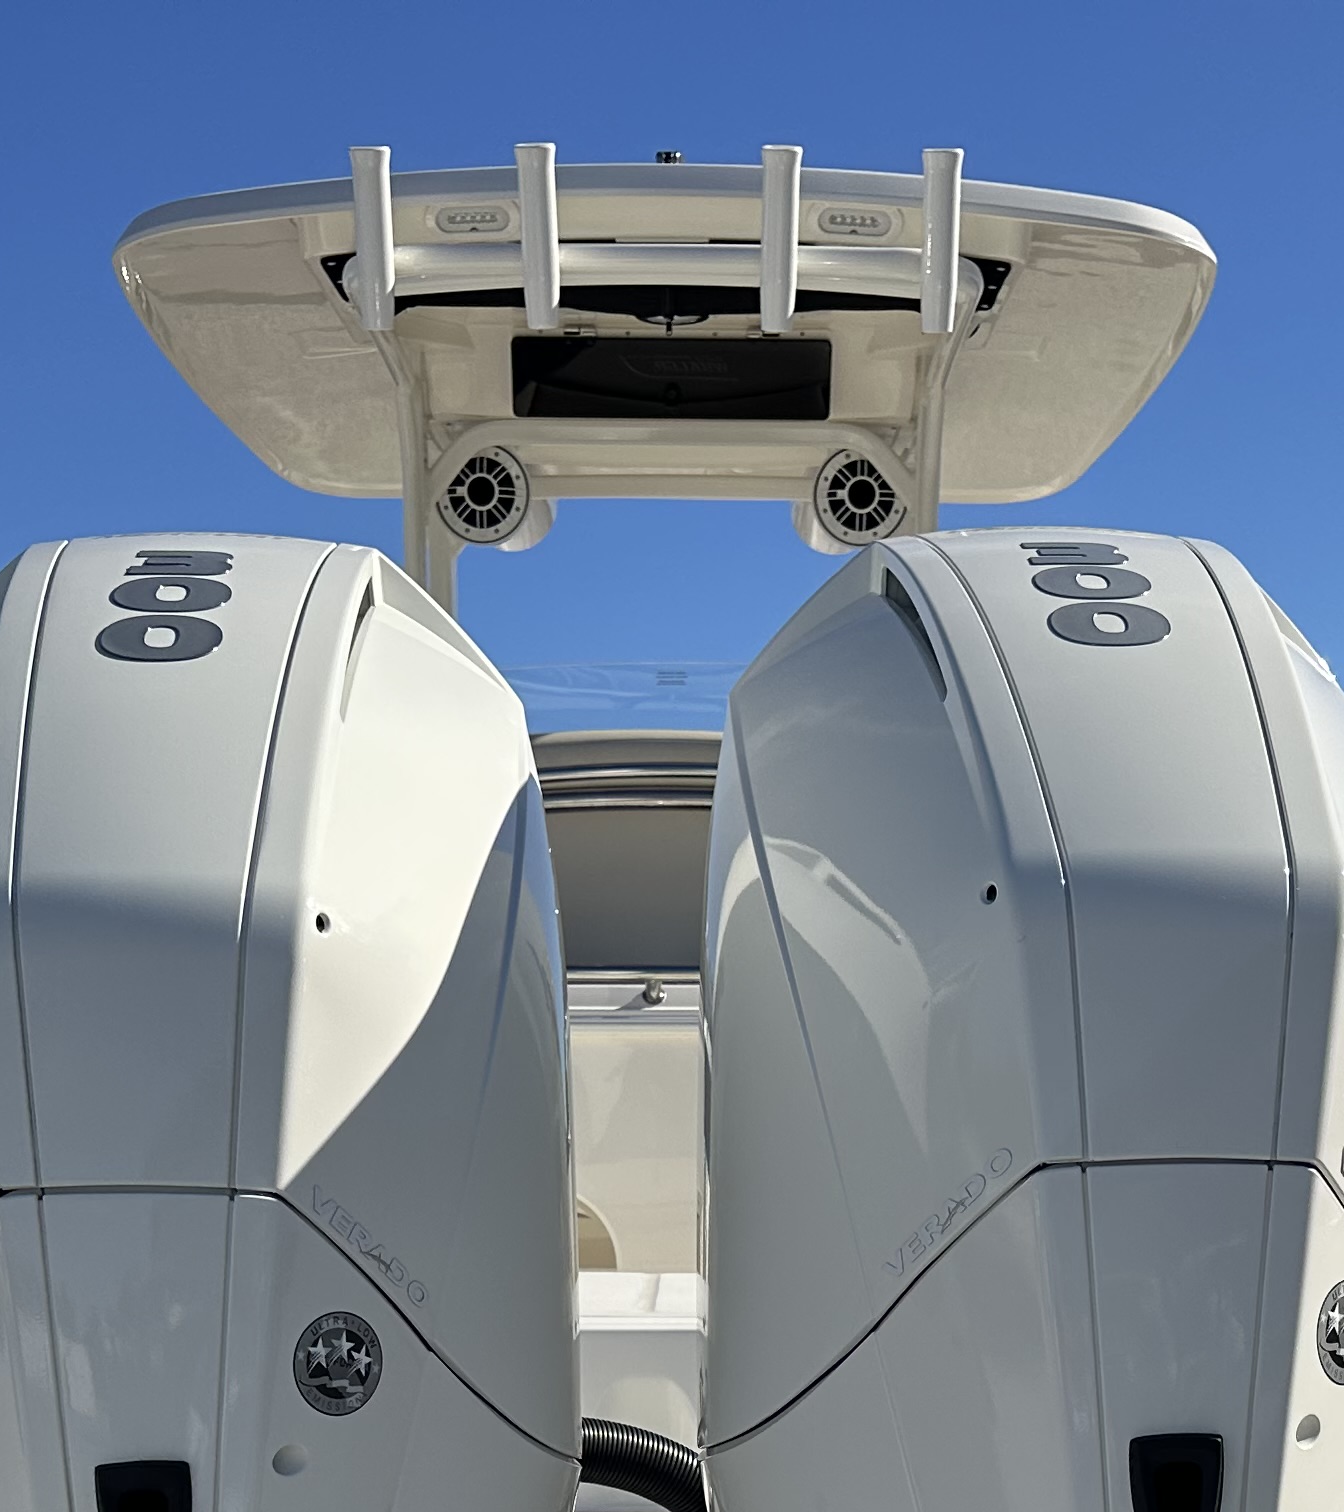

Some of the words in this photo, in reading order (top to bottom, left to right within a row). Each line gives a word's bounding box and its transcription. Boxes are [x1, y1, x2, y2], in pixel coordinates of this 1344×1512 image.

[94, 550, 234, 662] 300
[1020, 541, 1172, 647] 300
[310, 1183, 431, 1309] VERADO
[882, 1147, 1013, 1277] VERADO
[310, 1315, 349, 1337] ULTRA
